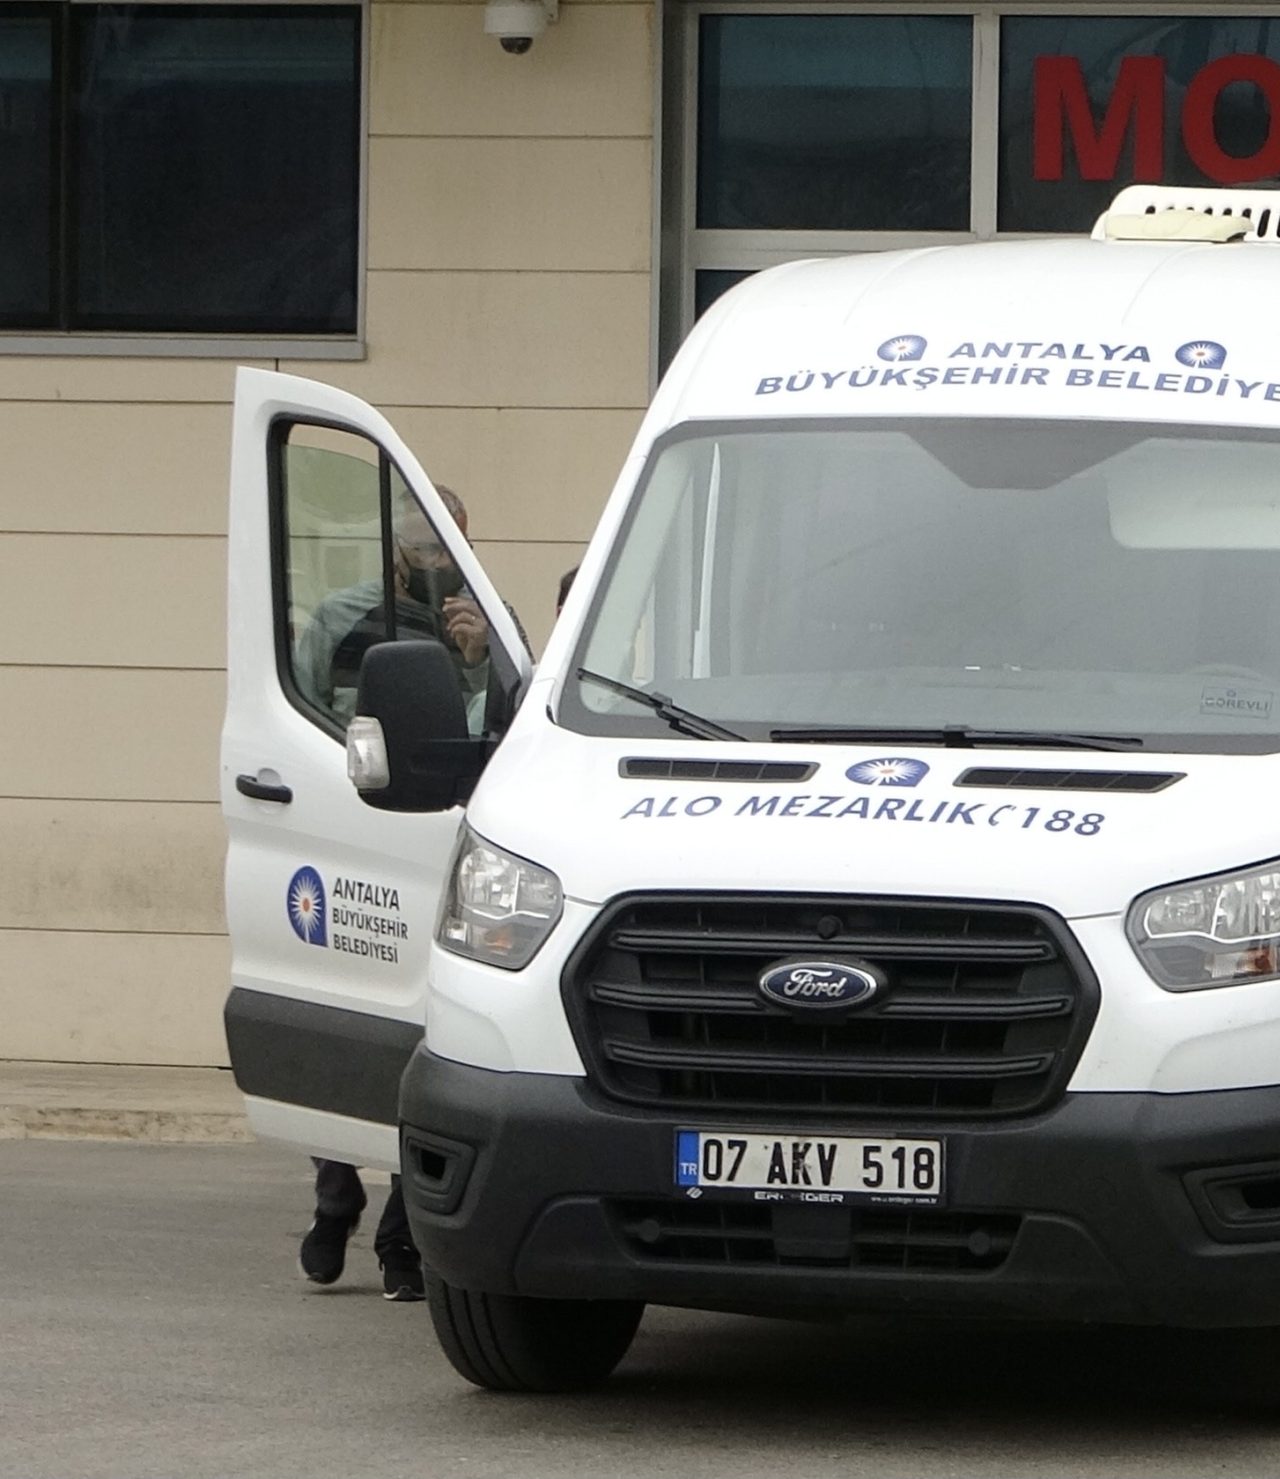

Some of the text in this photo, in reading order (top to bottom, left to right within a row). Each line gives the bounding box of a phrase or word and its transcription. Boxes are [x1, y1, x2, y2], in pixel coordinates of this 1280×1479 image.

[947, 341, 1153, 364] ANTALYA
[754, 362, 1051, 396] BÜYÜKŞEHİR
[620, 795, 1107, 837] ALO MEZARLIK 188
[332, 877, 400, 912] ANTALYA
[332, 904, 409, 940] BÜYÜKŞEHİR
[333, 934, 399, 964] BELEDİYESİ
[783, 968, 848, 998] Ford
[680, 1139, 936, 1191] TR 07 AKV 518
